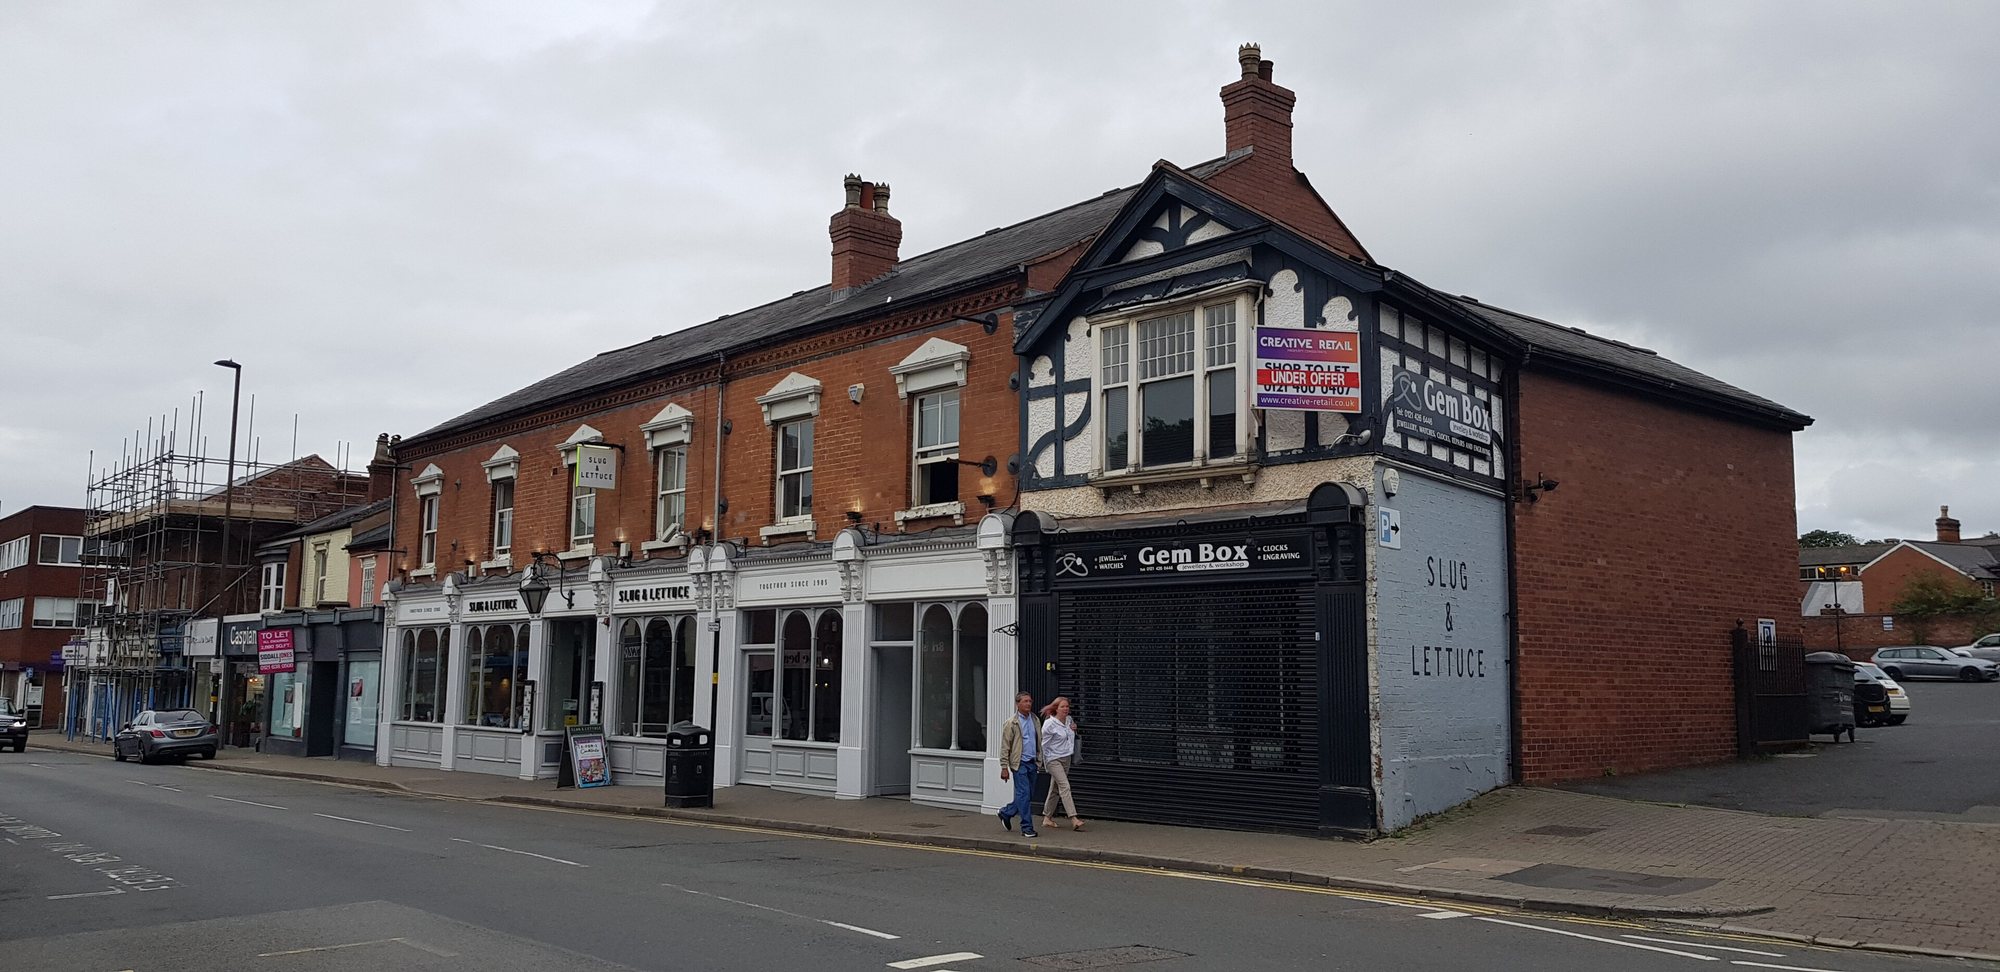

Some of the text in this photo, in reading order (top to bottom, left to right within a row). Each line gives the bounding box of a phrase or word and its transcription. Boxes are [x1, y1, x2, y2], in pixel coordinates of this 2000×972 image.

[1260, 336, 1353, 351] CREATIVE RETAIL
[1271, 370, 1345, 386] UNDER OFFER
[1260, 396, 1355, 407] www.creative-retail.co.uk
[1423, 379, 1491, 432] Gem Box
[588, 456, 607, 464] SLUG
[580, 471, 613, 480] LETTUCE
[1138, 543, 1249, 565] Gem Box
[1262, 544, 1288, 552] CLOCKS
[1262, 552, 1300, 560] ENGRAVING
[1099, 562, 1124, 570] WATCHES
[1182, 563, 1207, 571] jewellery
[1214, 560, 1245, 569] workshop
[1427, 555, 1468, 591] SLUG
[790, 580, 809, 588] SINCE
[618, 586, 690, 602] SLUG & LETTUCE
[469, 601, 484, 612] SLUG
[489, 599, 518, 611] LETTUCE
[1445, 601, 1454, 632] &
[230, 626, 257, 653] Caspian
[274, 630, 290, 638] LET
[1411, 645, 1485, 678] LETTUCE
